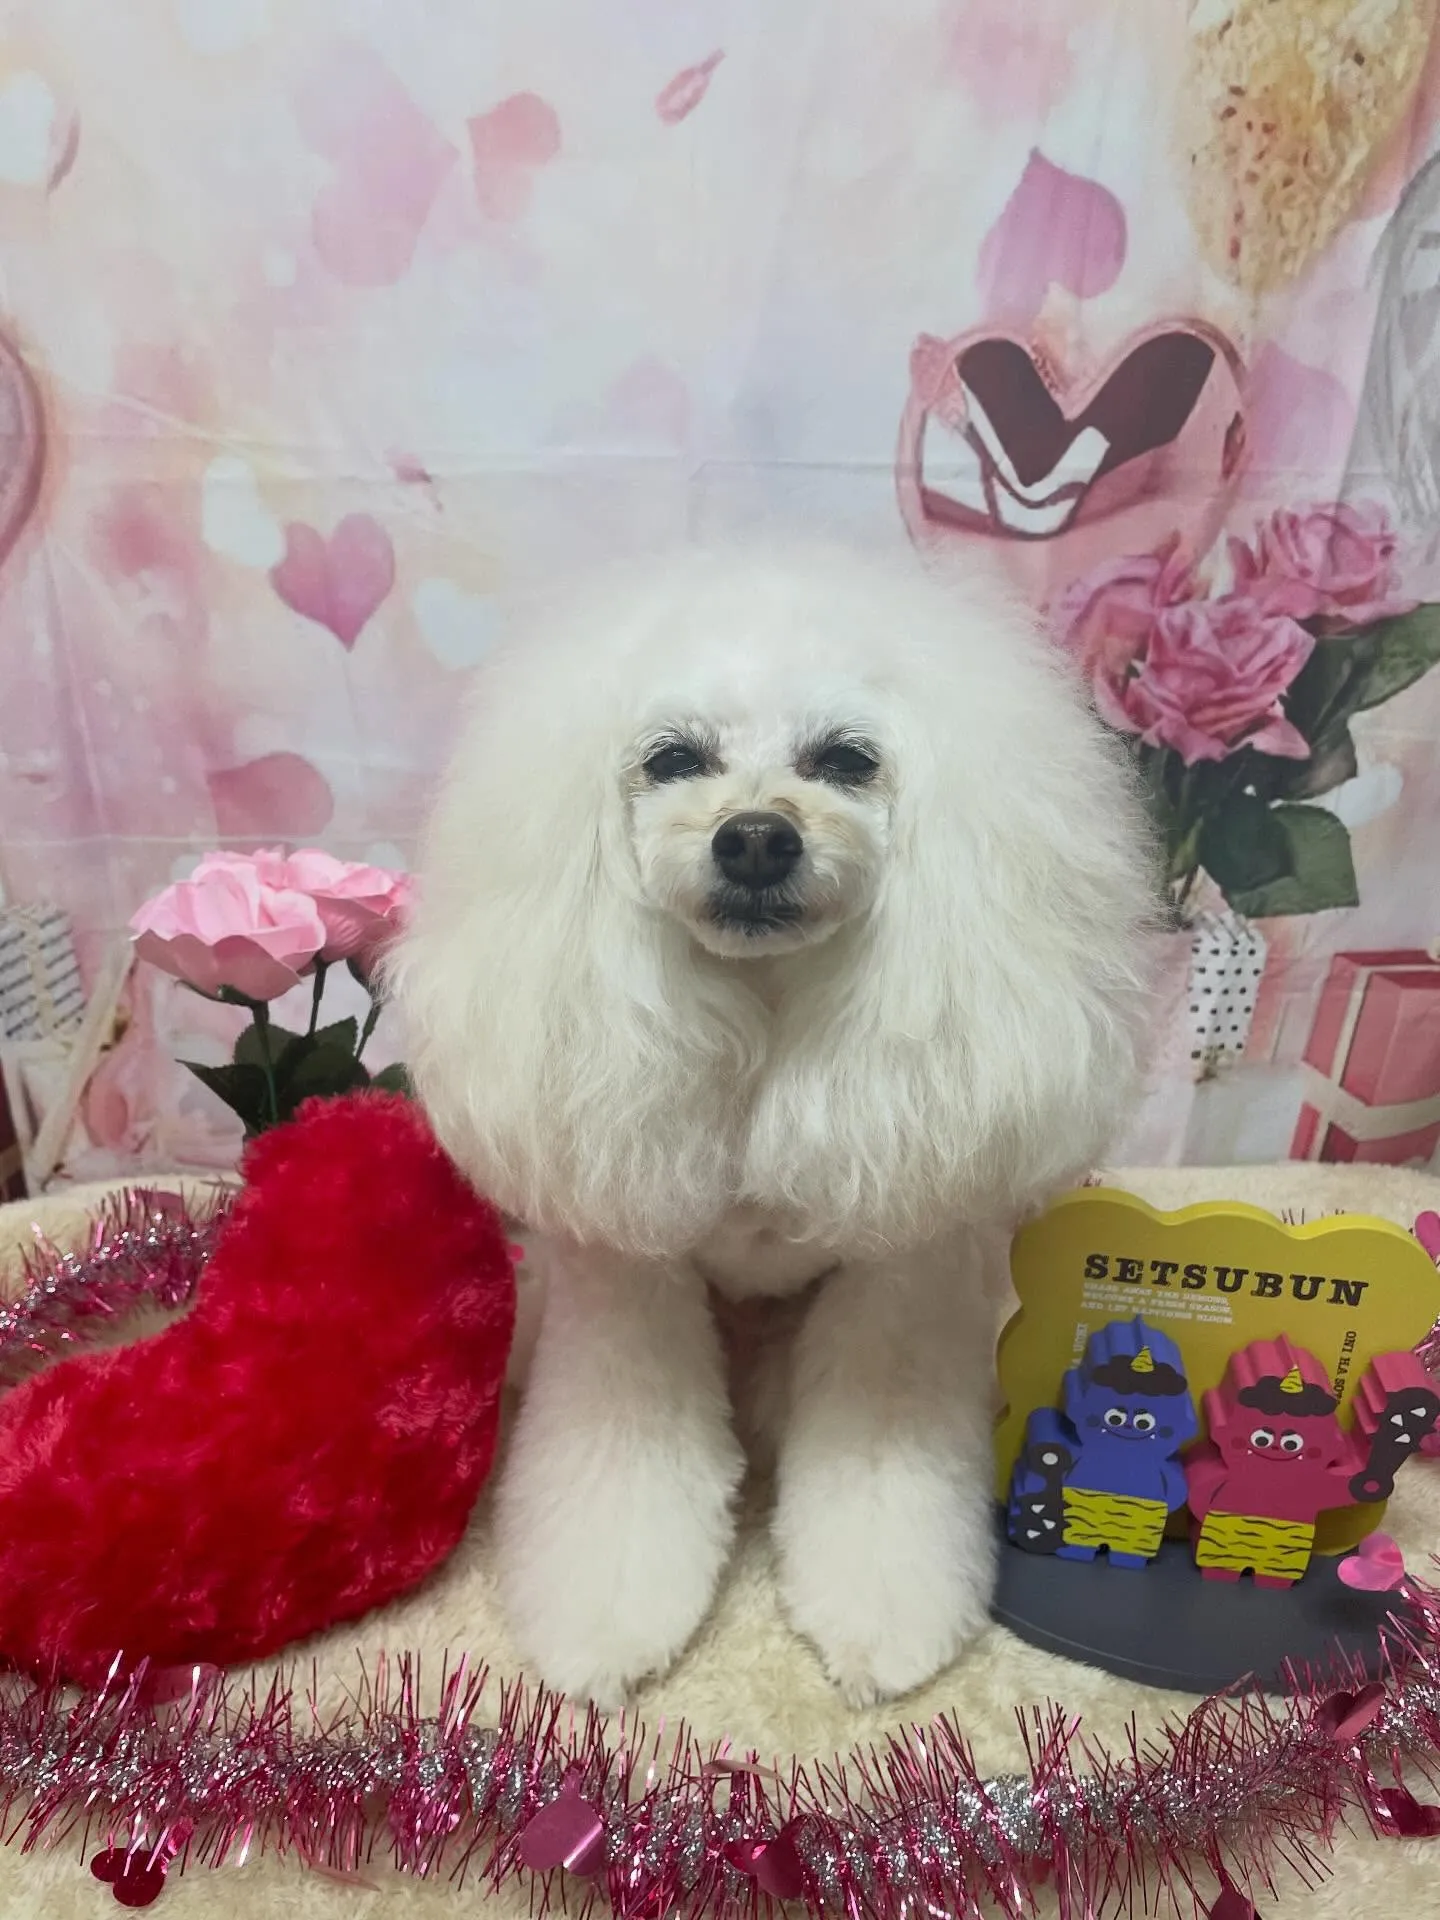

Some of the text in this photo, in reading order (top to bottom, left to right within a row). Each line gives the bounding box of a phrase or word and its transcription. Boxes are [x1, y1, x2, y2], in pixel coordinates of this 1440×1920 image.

[1084, 1254, 1369, 1307] SETSUBUN
[1138, 1297, 1147, 1305] A
[1156, 1290, 1180, 1299] THE
[1081, 1301, 1104, 1310] AND
[1342, 1331, 1357, 1353] ONI
[1337, 1357, 1351, 1375] HA
